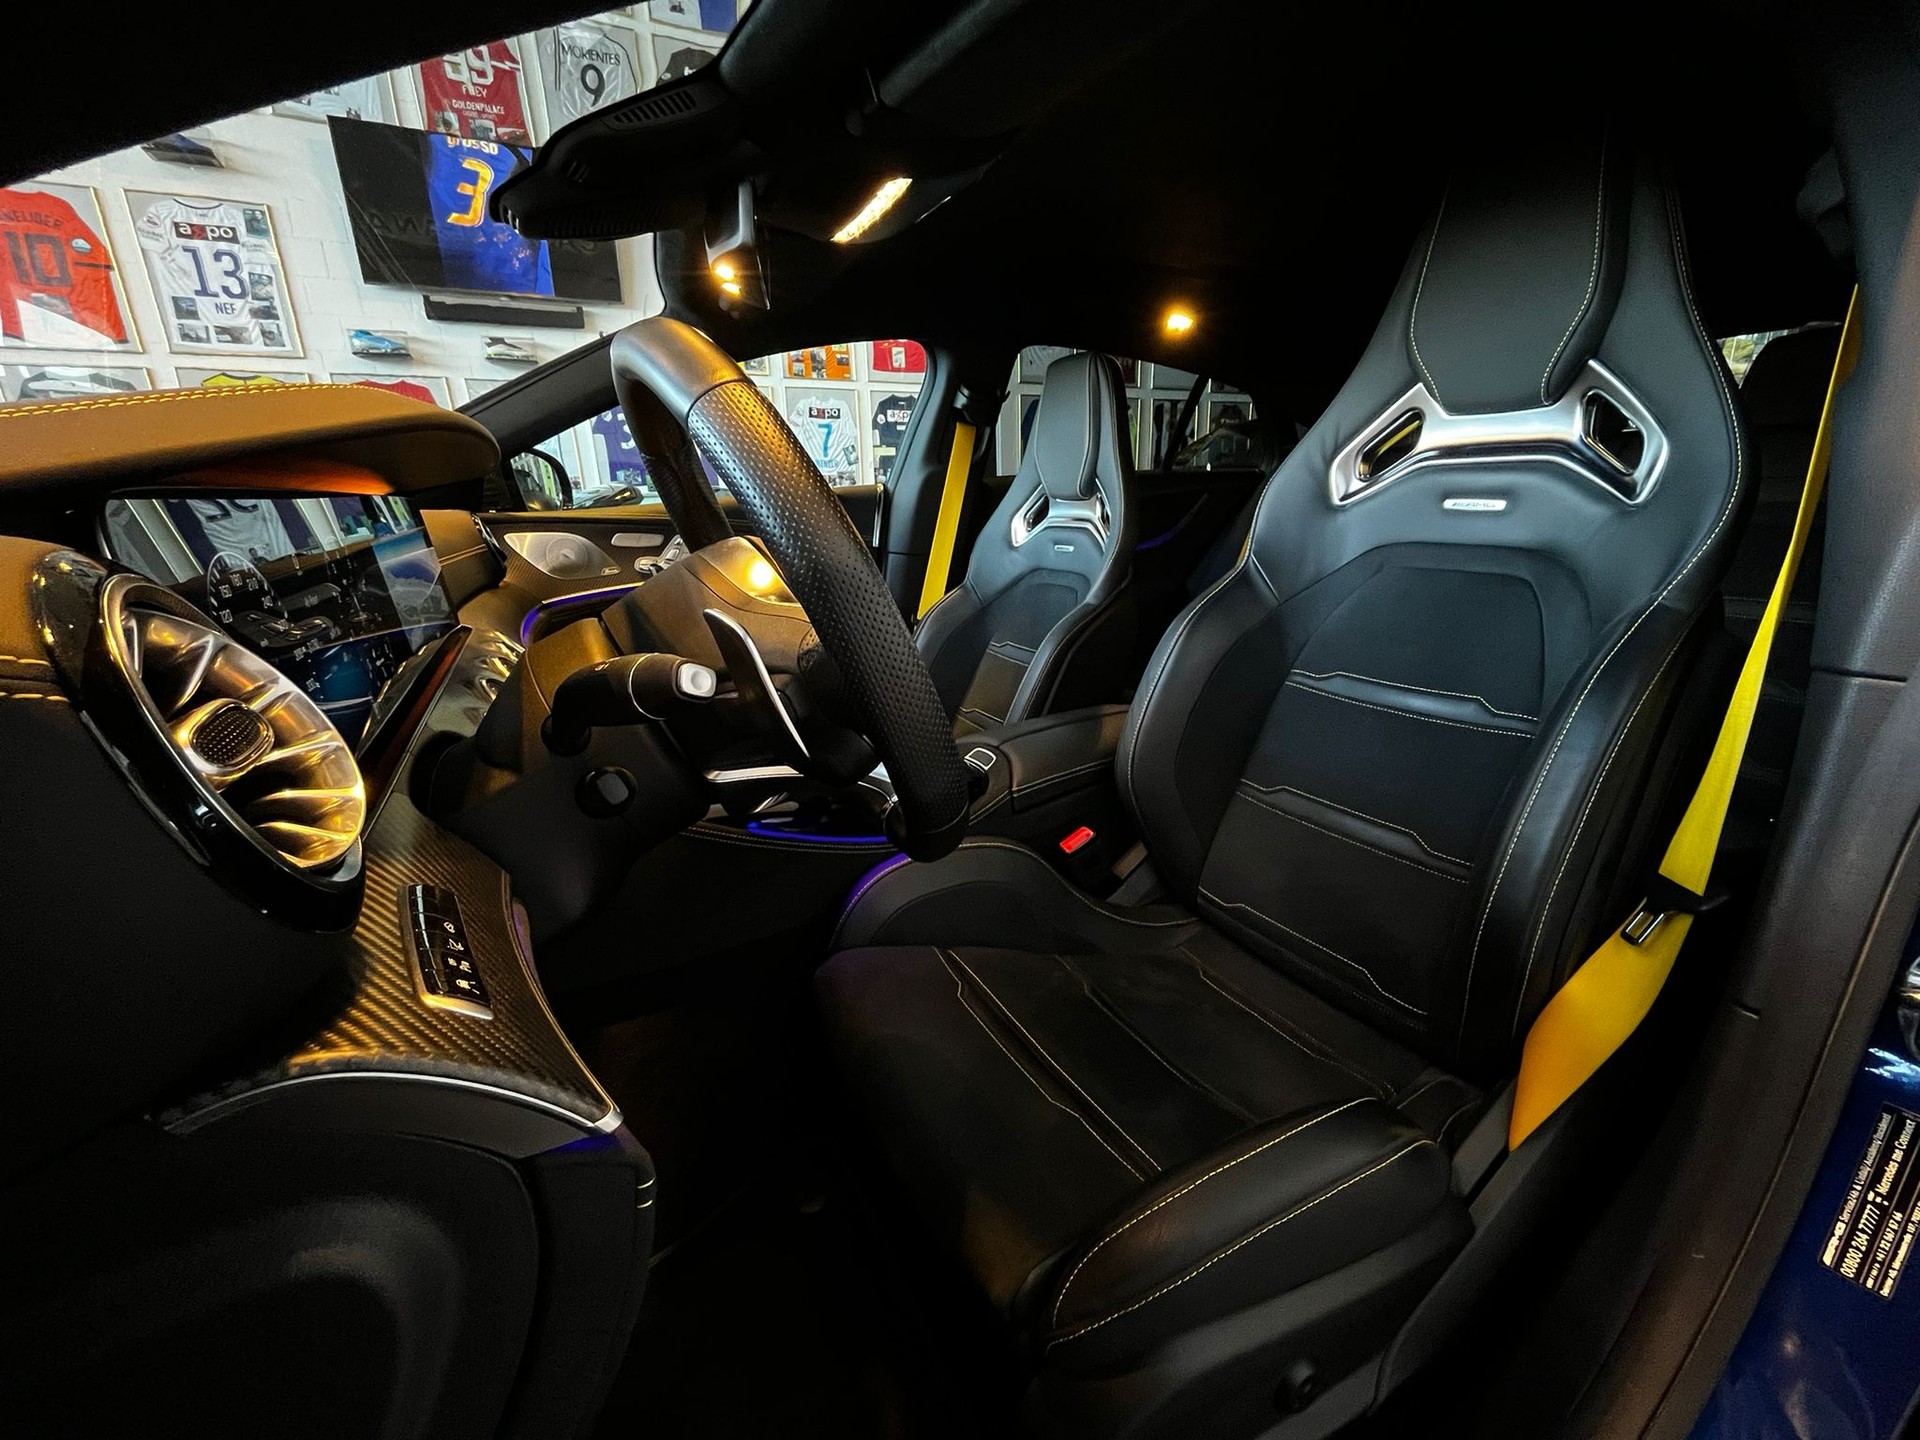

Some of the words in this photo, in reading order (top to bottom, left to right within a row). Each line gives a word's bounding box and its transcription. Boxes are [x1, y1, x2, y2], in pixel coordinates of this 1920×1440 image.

[561, 41, 622, 67] MORIENTES
[580, 63, 606, 108] 9
[452, 99, 505, 116] GOLDENPALACE
[446, 157, 495, 228] 3
[3, 230, 73, 288] 10
[181, 245, 250, 300] 13
[214, 302, 238, 316] NEF
[817, 422, 833, 458] 7
[1875, 1161, 1899, 1195] Mercedes
[1858, 1204, 1880, 1234] 77777
[1851, 1231, 1870, 1251] 264
[1840, 1248, 1863, 1278] 00800
